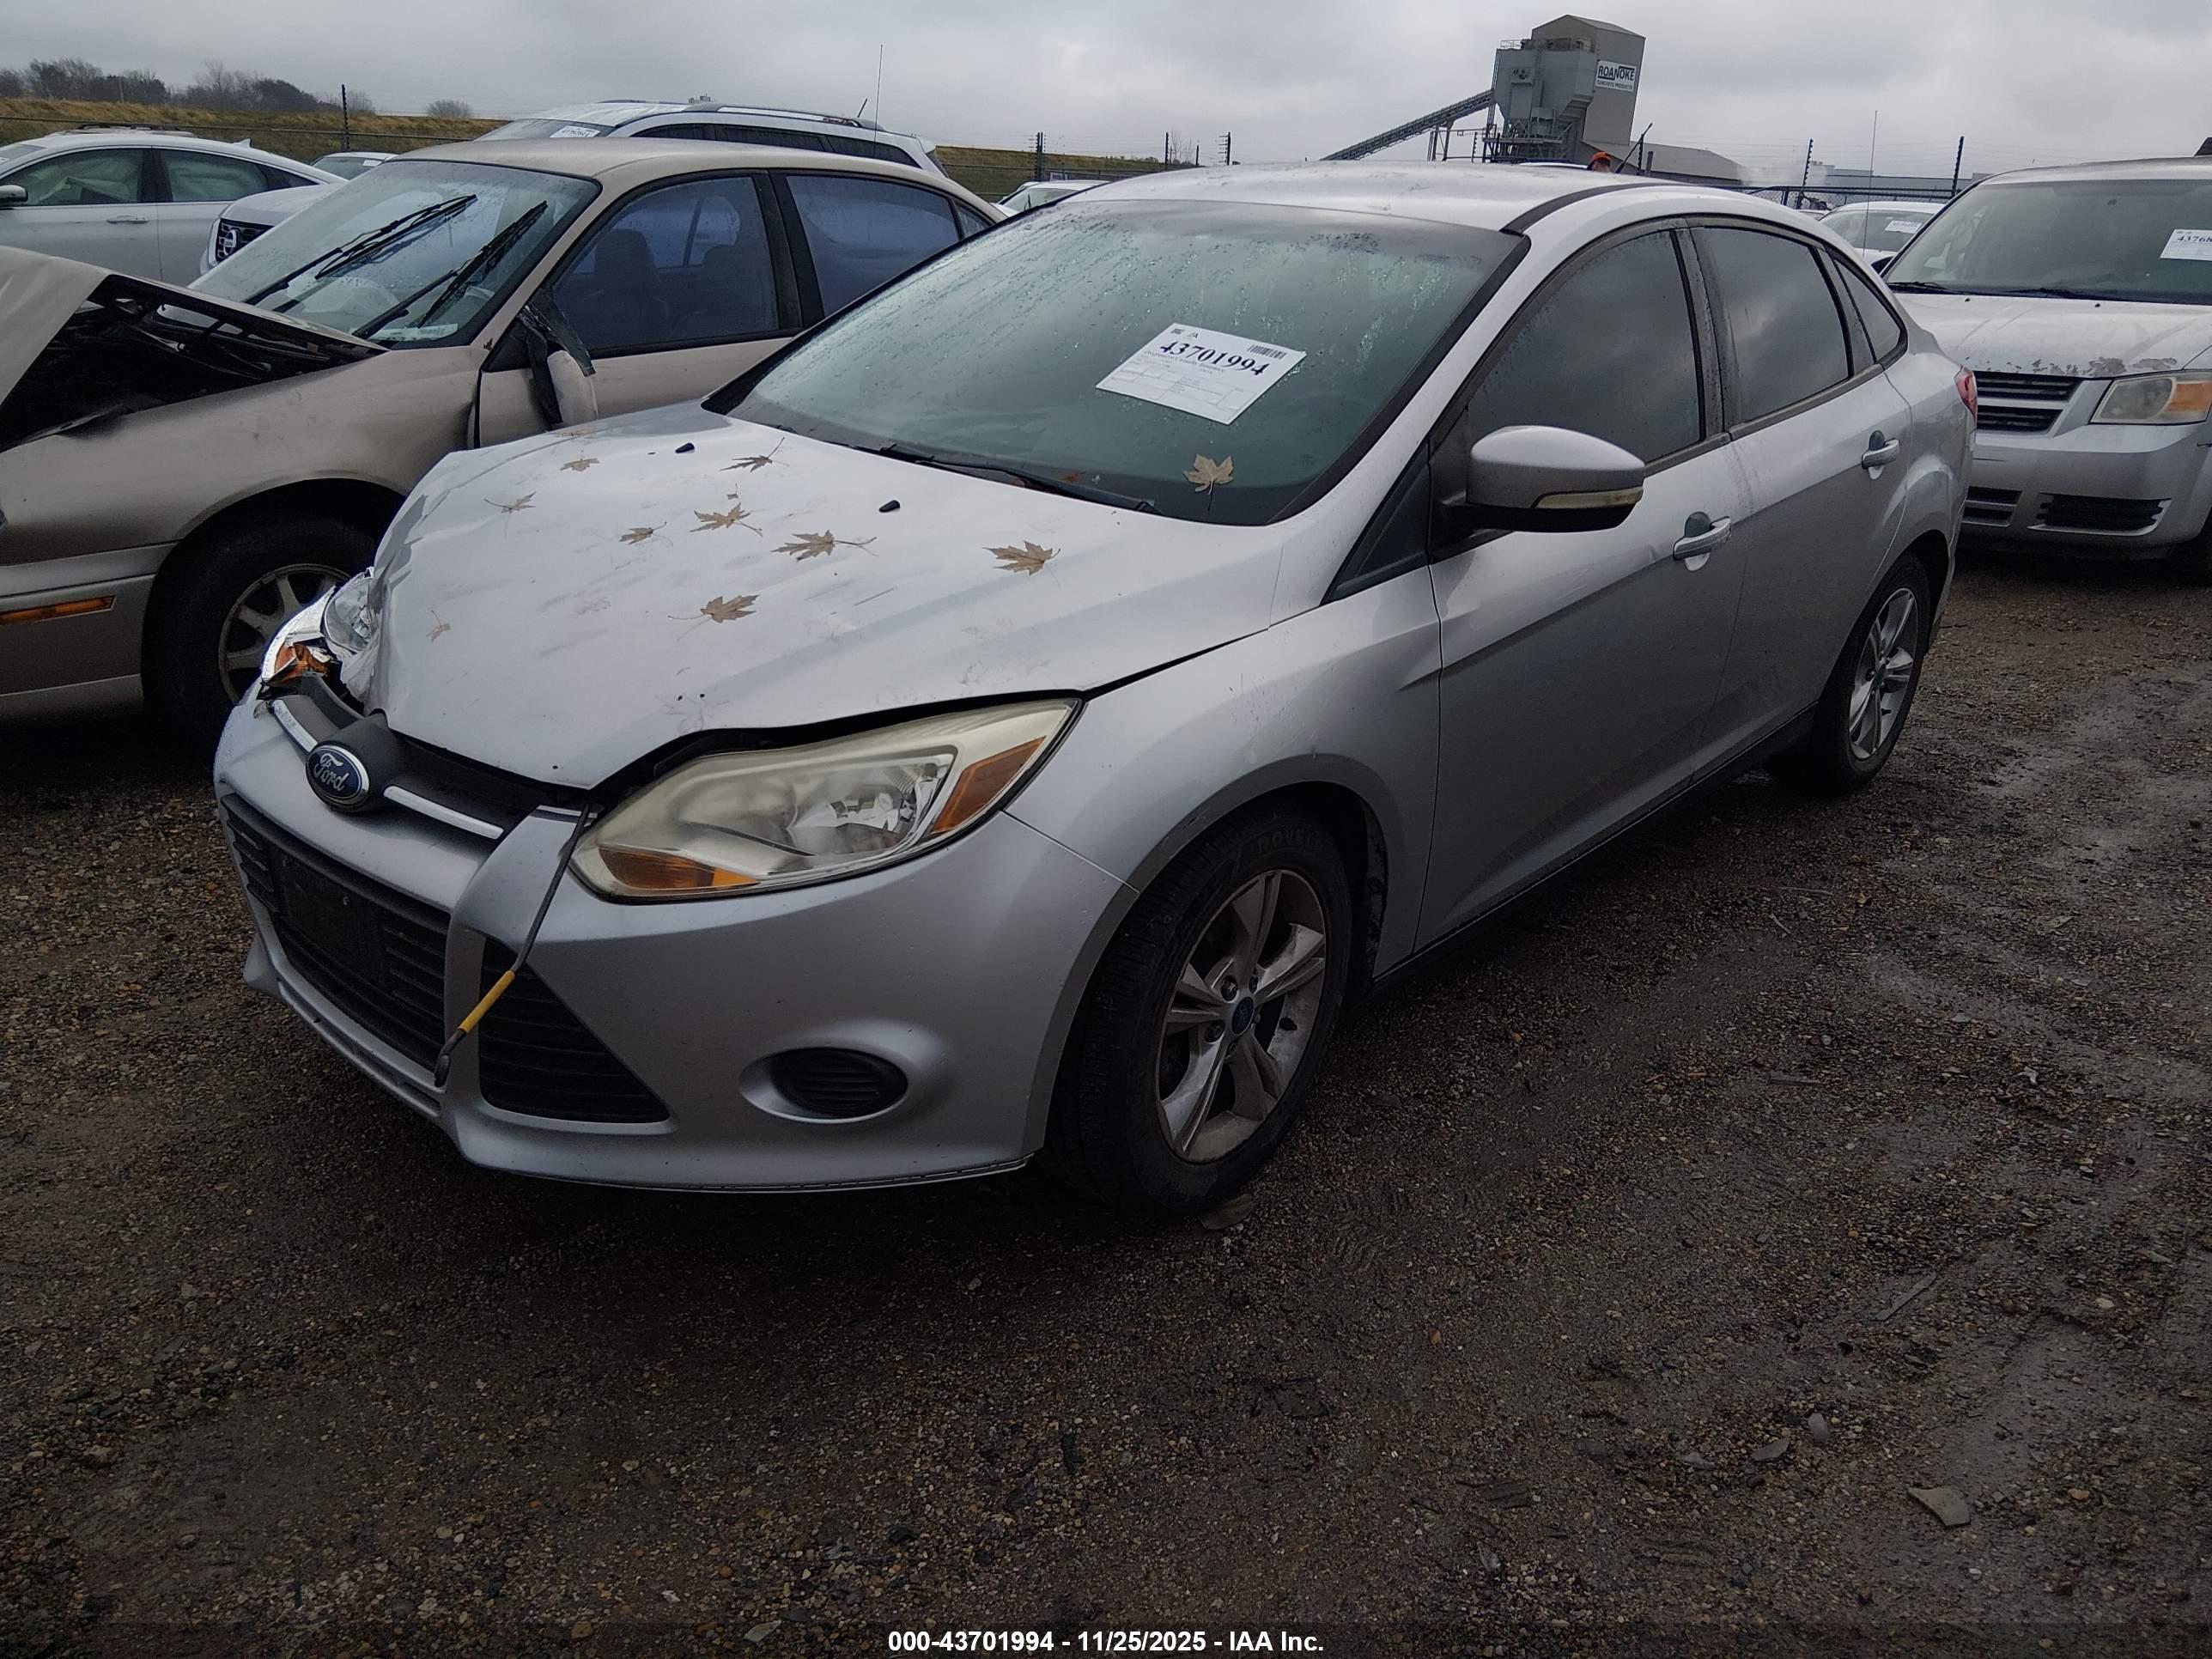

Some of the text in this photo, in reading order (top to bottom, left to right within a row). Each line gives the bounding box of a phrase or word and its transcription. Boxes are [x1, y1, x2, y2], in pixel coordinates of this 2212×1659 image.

[1598, 65, 1635, 81] ROANOKE
[1159, 341, 1271, 376] 43701994
[313, 752, 349, 792] Ford
